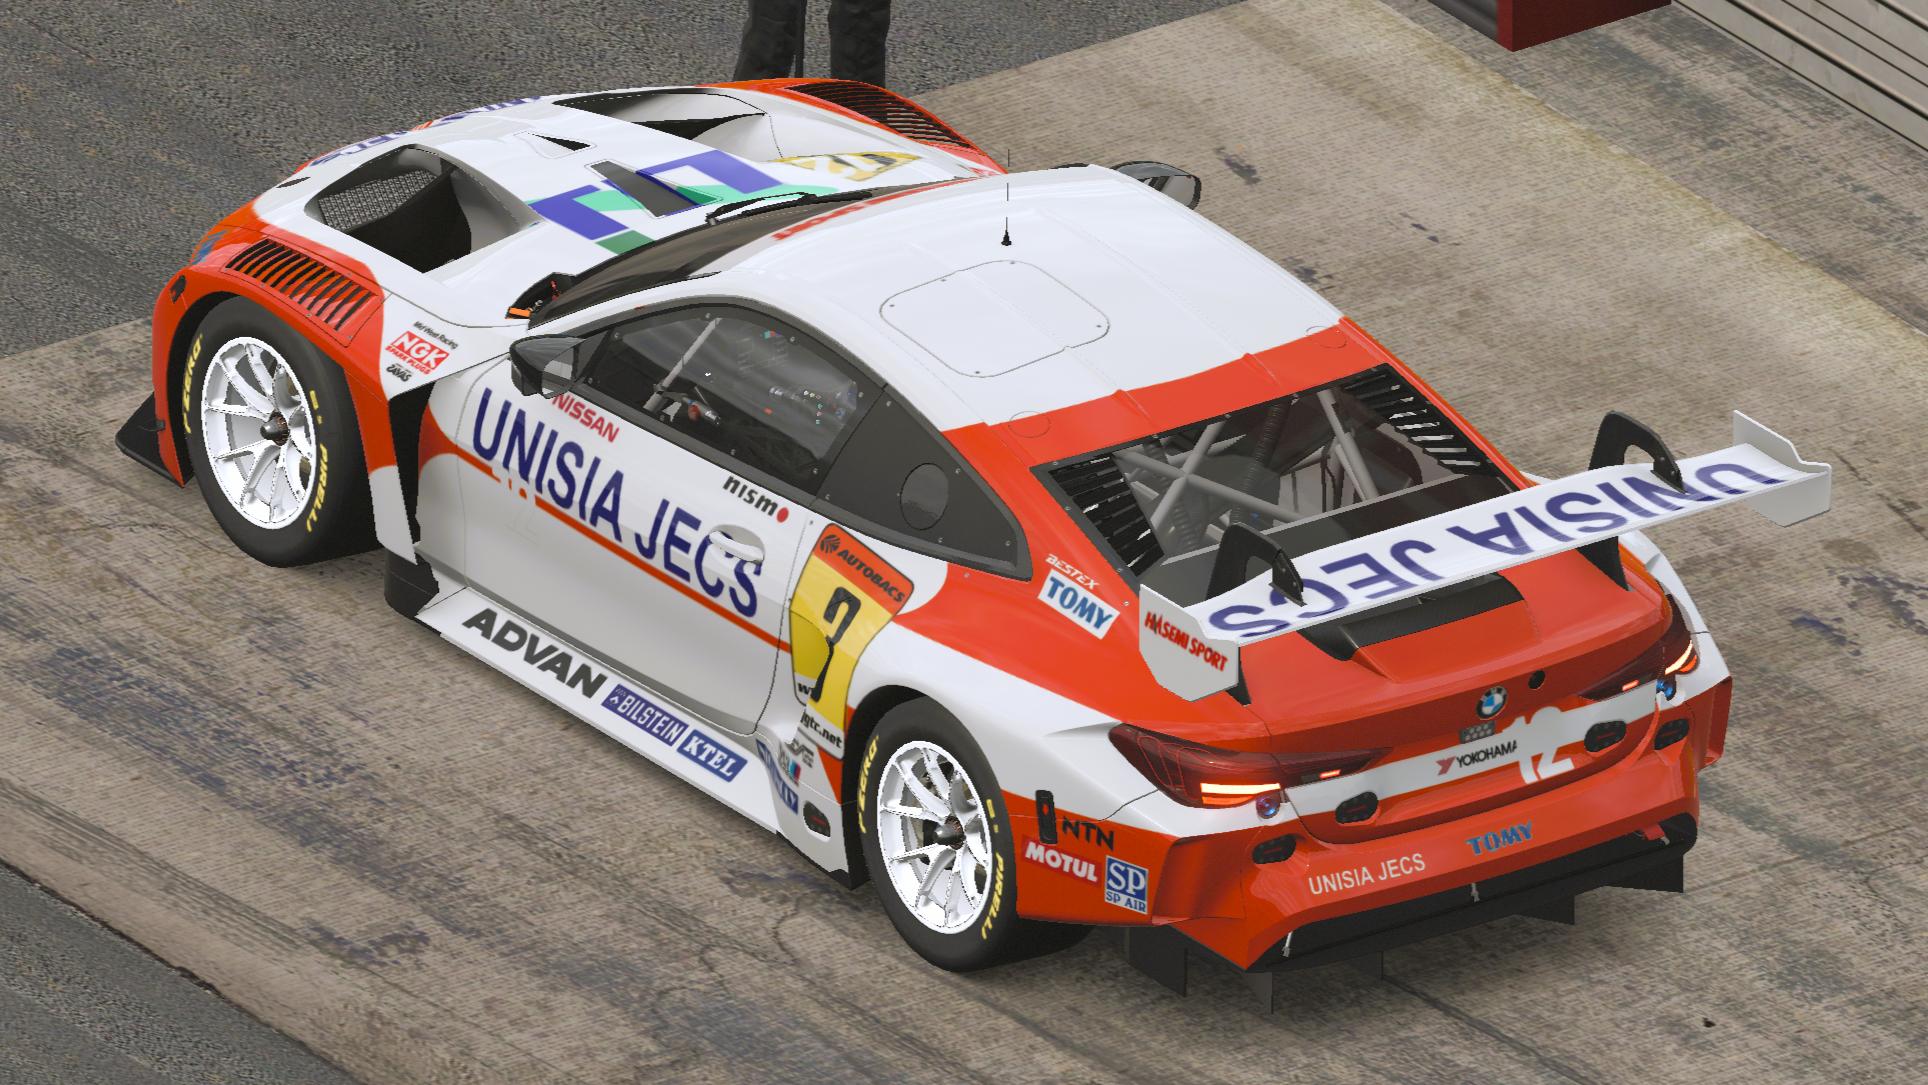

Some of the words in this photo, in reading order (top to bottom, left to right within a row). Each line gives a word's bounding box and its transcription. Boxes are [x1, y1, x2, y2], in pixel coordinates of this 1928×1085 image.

[384, 345, 408, 361] SPARK
[407, 358, 432, 375] PLUGS
[391, 333, 447, 369] NGK
[552, 393, 620, 443] NISSAN
[306, 443, 328, 532] PIRELLI
[473, 387, 624, 543] UNISIA
[635, 498, 763, 618] JECS
[1446, 463, 1787, 556] UNISIA
[837, 548, 906, 603] AUTOBACS
[1045, 553, 1099, 590] BESTEX
[1208, 539, 1447, 639] JECS
[1048, 576, 1114, 630] TOMY
[462, 607, 608, 700] ADVAN
[1144, 611, 1190, 651] HASEMI
[1189, 637, 1229, 672] SPORT
[616, 693, 685, 743] BILSTEIN
[684, 735, 738, 779] KTEL
[1062, 815, 1115, 851] NTN
[1465, 820, 1534, 856] TOMY
[1025, 841, 1099, 882] MOTUL
[1107, 861, 1146, 897] SP
[1309, 866, 1375, 895] UNISIA
[1378, 853, 1426, 882] JECS
[982, 852, 1004, 939] PIRELLI
[1105, 891, 1121, 904] SP
[1124, 897, 1147, 913] AIR
